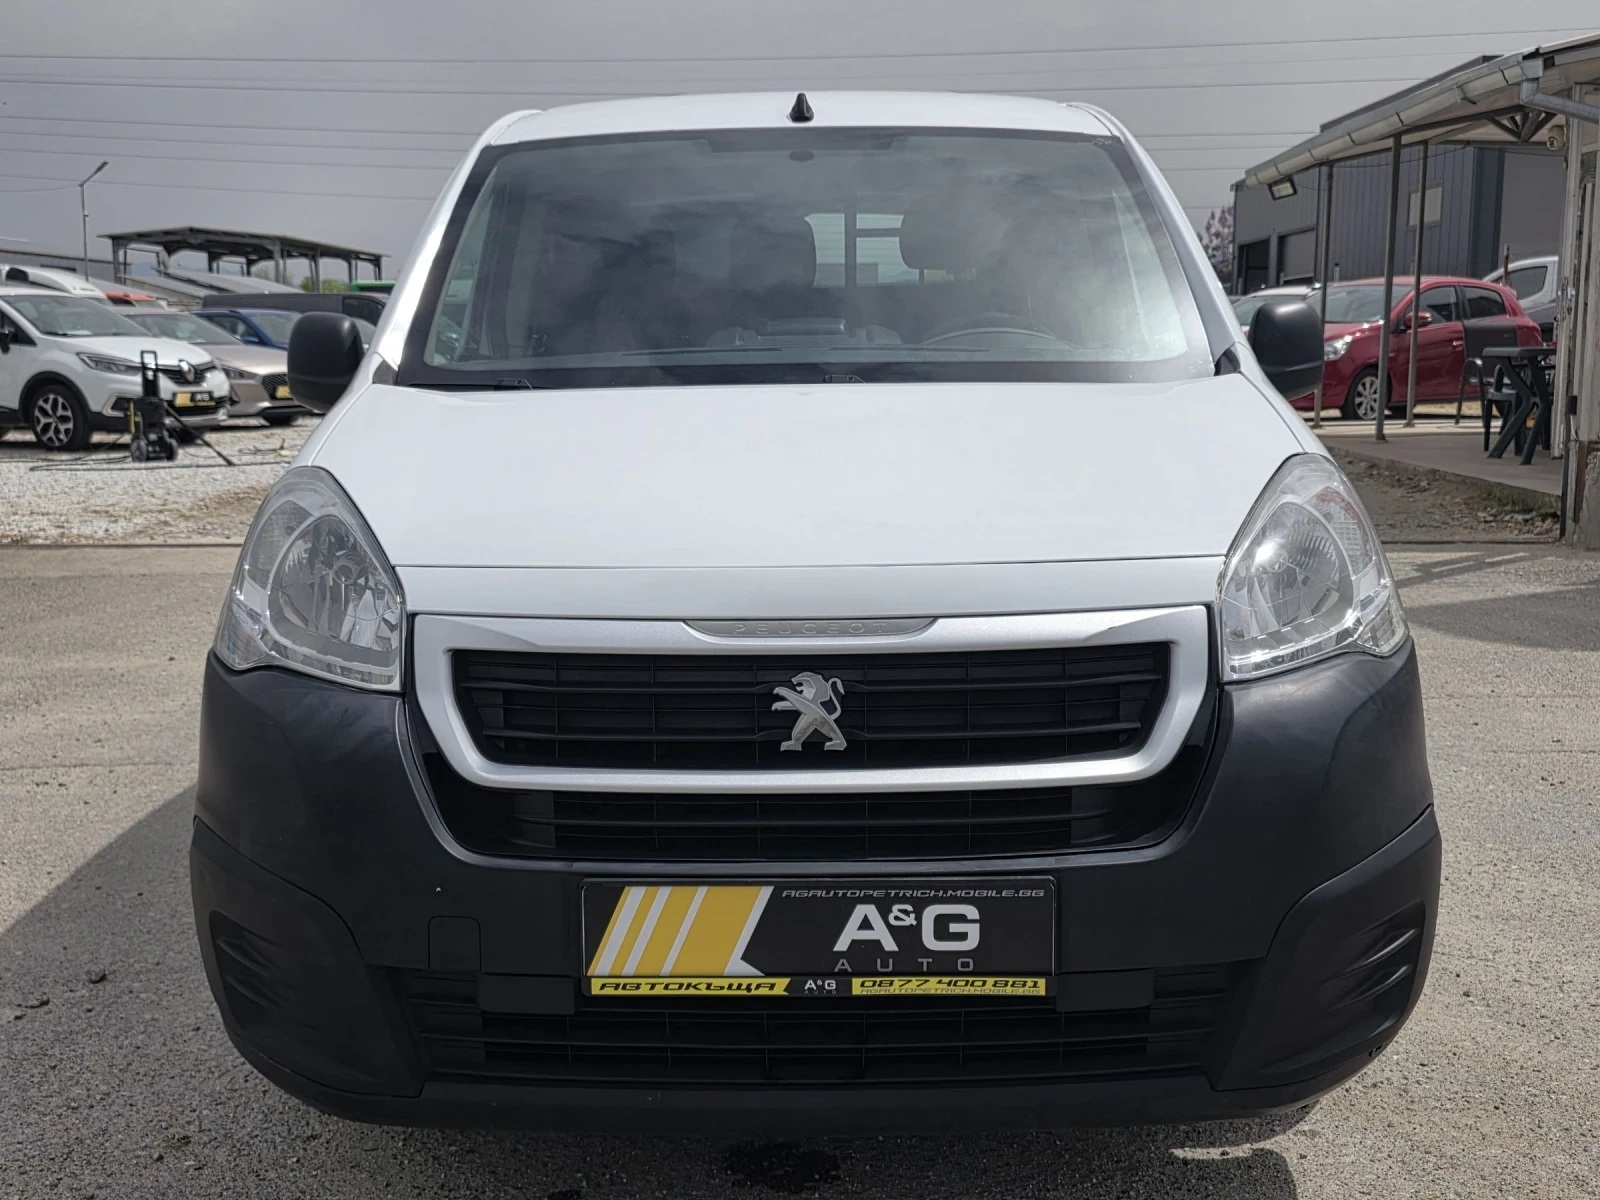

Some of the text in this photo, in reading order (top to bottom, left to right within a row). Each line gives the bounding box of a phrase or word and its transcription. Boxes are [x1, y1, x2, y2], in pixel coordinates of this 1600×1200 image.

[732, 622, 888, 635] PEUGEOT
[781, 888, 1046, 899] AGAUTOPETRICH.MOBILE.BG
[832, 903, 981, 952] A&G
[833, 957, 974, 973] AUTO
[599, 982, 777, 993] АВТОКЪЩА
[860, 979, 1041, 989] 0877 400 881
